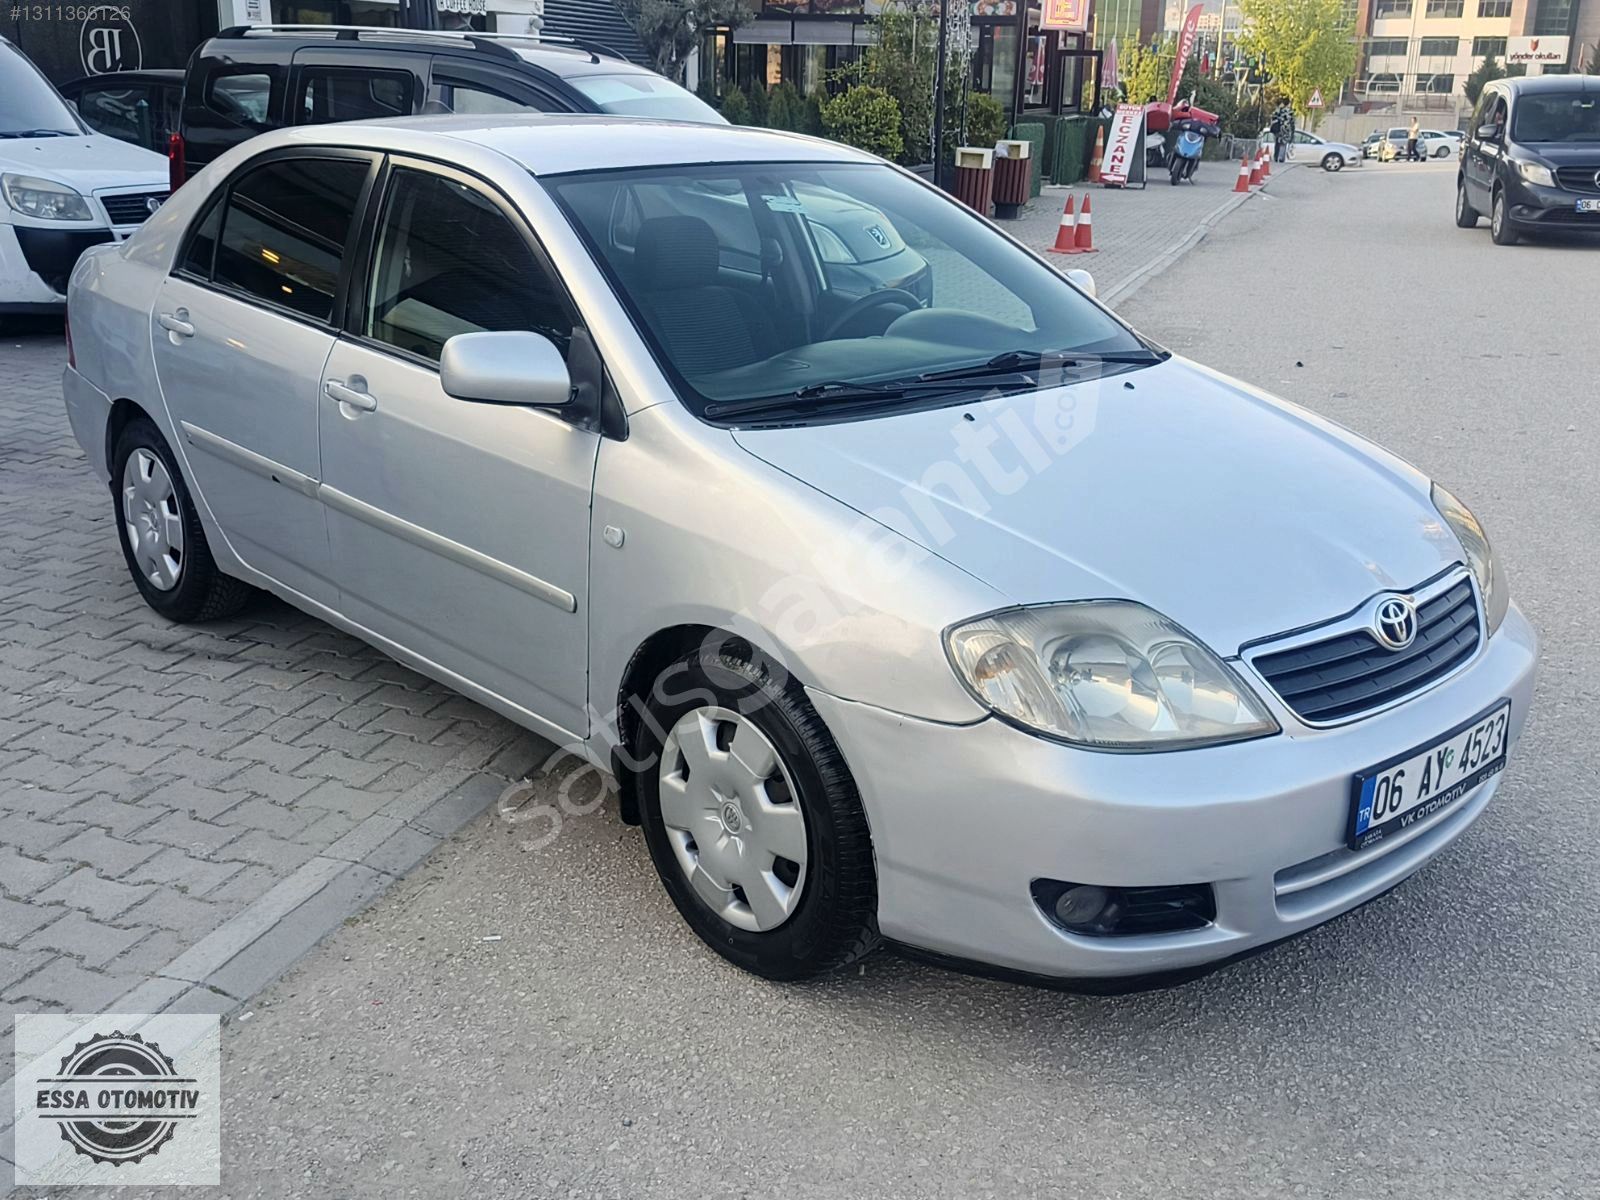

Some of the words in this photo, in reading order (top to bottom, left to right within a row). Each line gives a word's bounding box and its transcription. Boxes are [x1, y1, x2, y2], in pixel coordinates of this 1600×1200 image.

[468, 0, 486, 11] HOUSE
[1109, 115, 1134, 173] ECZANE
[1581, 200, 1592, 209] 06
[1358, 806, 1371, 823] TR
[1373, 769, 1405, 821] 06
[1417, 746, 1449, 800] AY
[1458, 712, 1505, 774] 4523
[1401, 811, 1417, 827] VK
